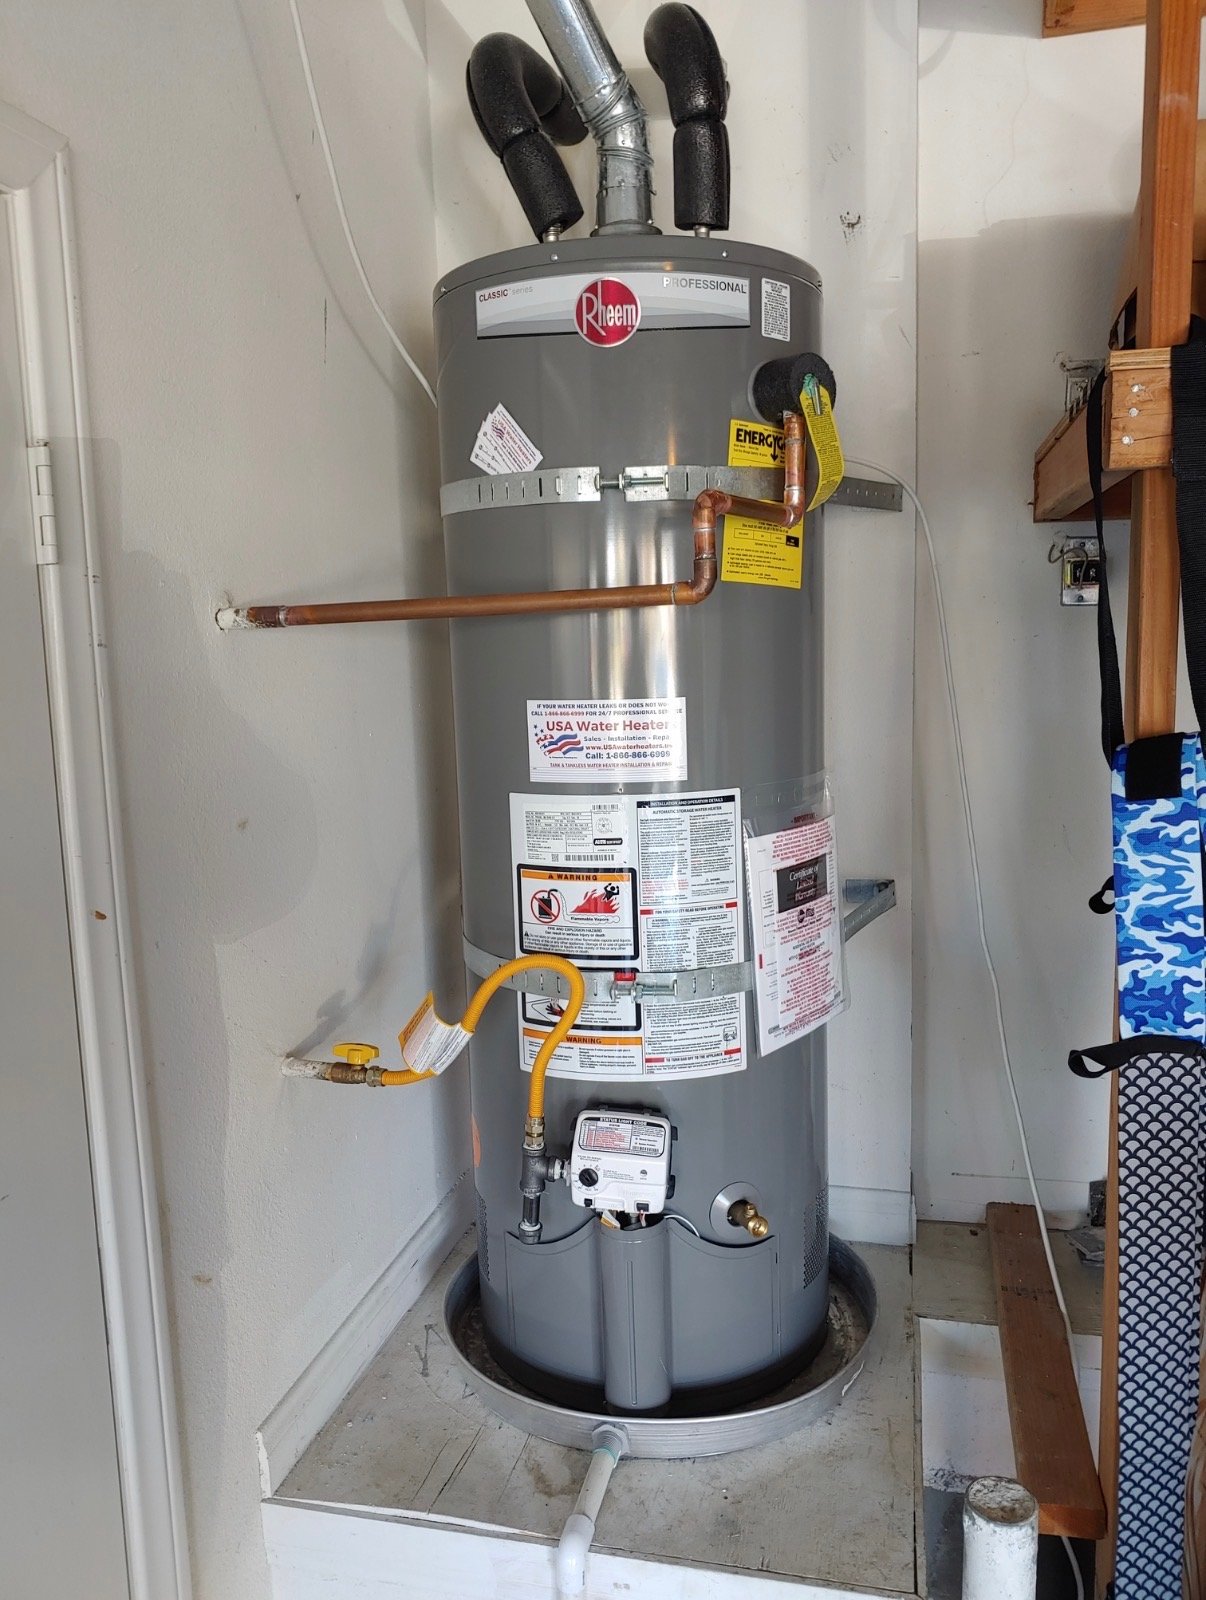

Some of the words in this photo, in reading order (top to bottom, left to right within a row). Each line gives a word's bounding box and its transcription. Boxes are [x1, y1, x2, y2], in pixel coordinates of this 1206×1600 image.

[662, 276, 746, 294] PROFESSIONAL
[478, 288, 508, 302] CLASSIC
[512, 286, 534, 296] series
[582, 280, 636, 336] Rheem
[736, 427, 785, 451] ENERGYG
[546, 720, 574, 732] USA
[576, 720, 620, 732] Water
[623, 720, 672, 731] Heater
[606, 750, 670, 759] 1-866-866-6999
[566, 1036, 602, 1044] WARNING
